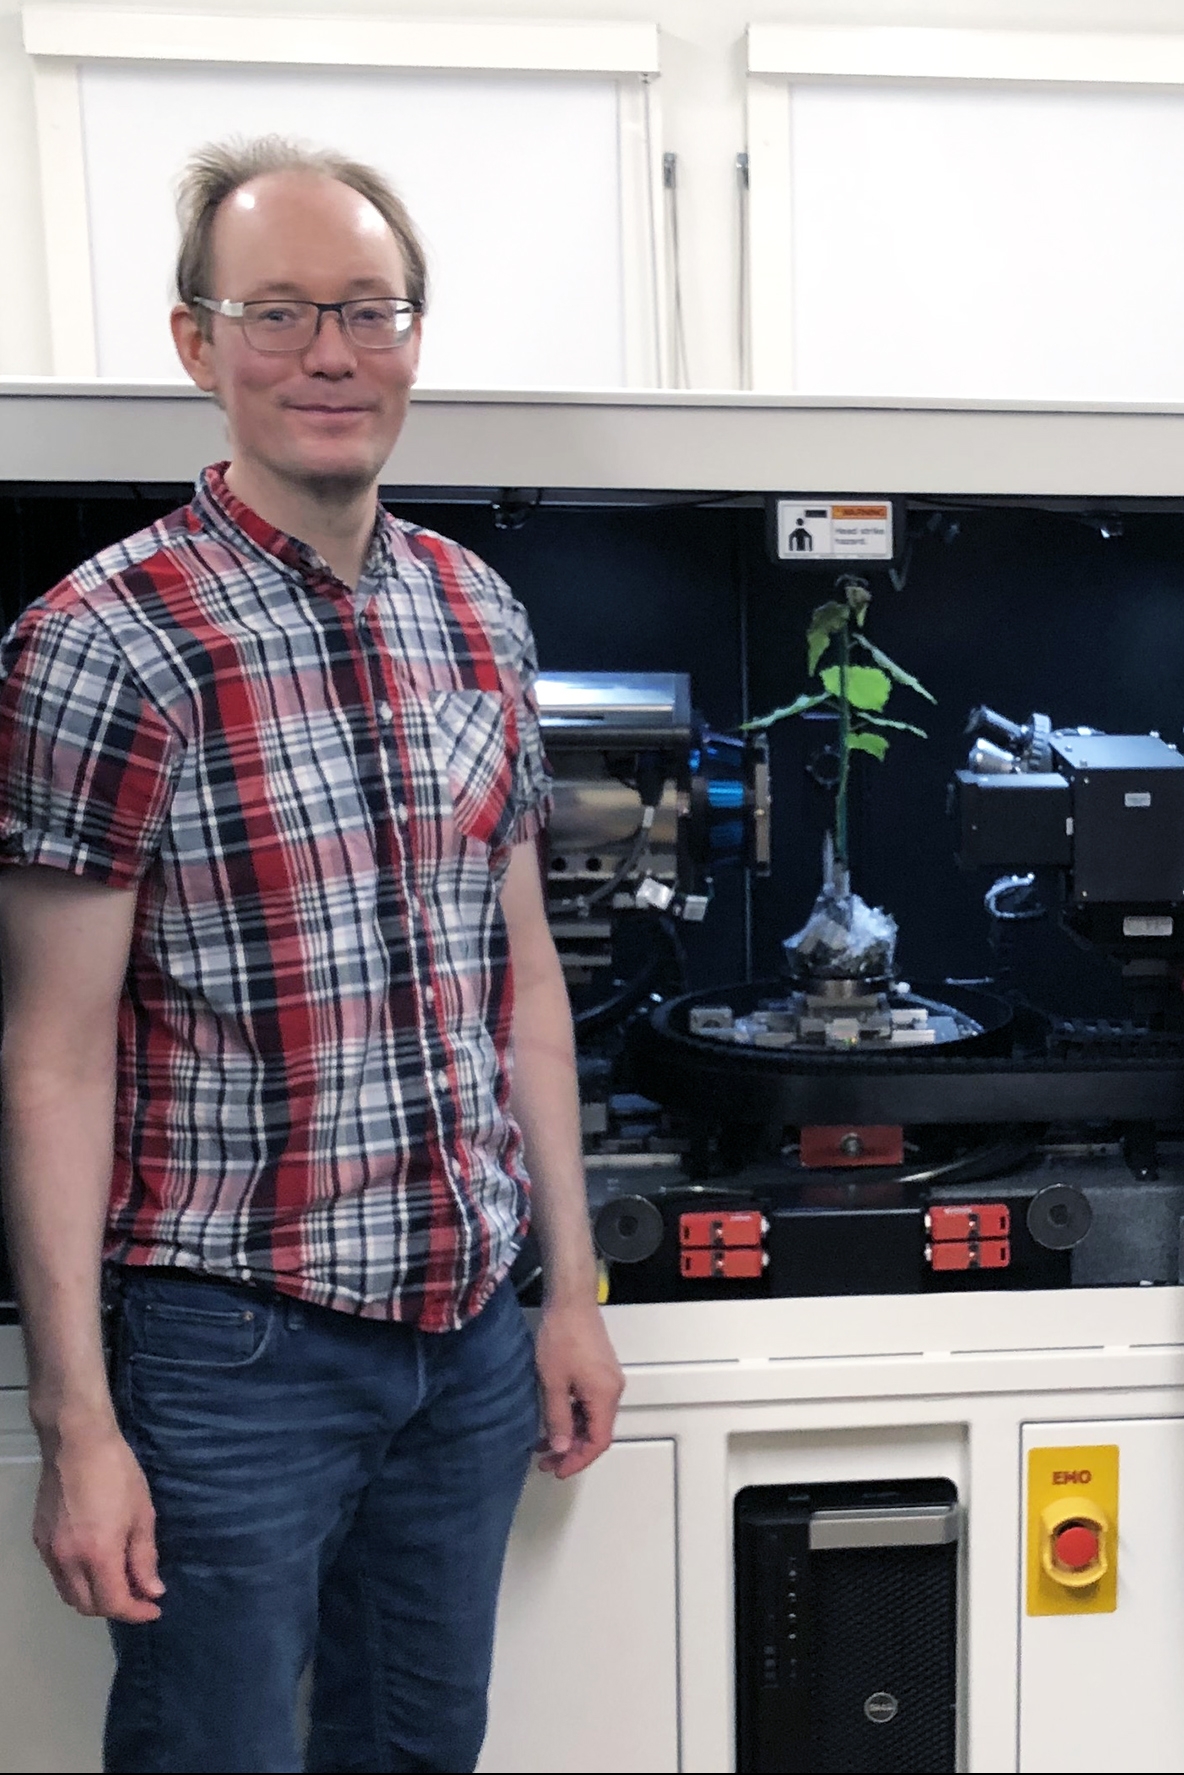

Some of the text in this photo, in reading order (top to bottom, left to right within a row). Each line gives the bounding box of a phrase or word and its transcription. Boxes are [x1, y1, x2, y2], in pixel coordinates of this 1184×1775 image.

[835, 527, 885, 535] Head strike
[1052, 1469, 1092, 1485] EMO
